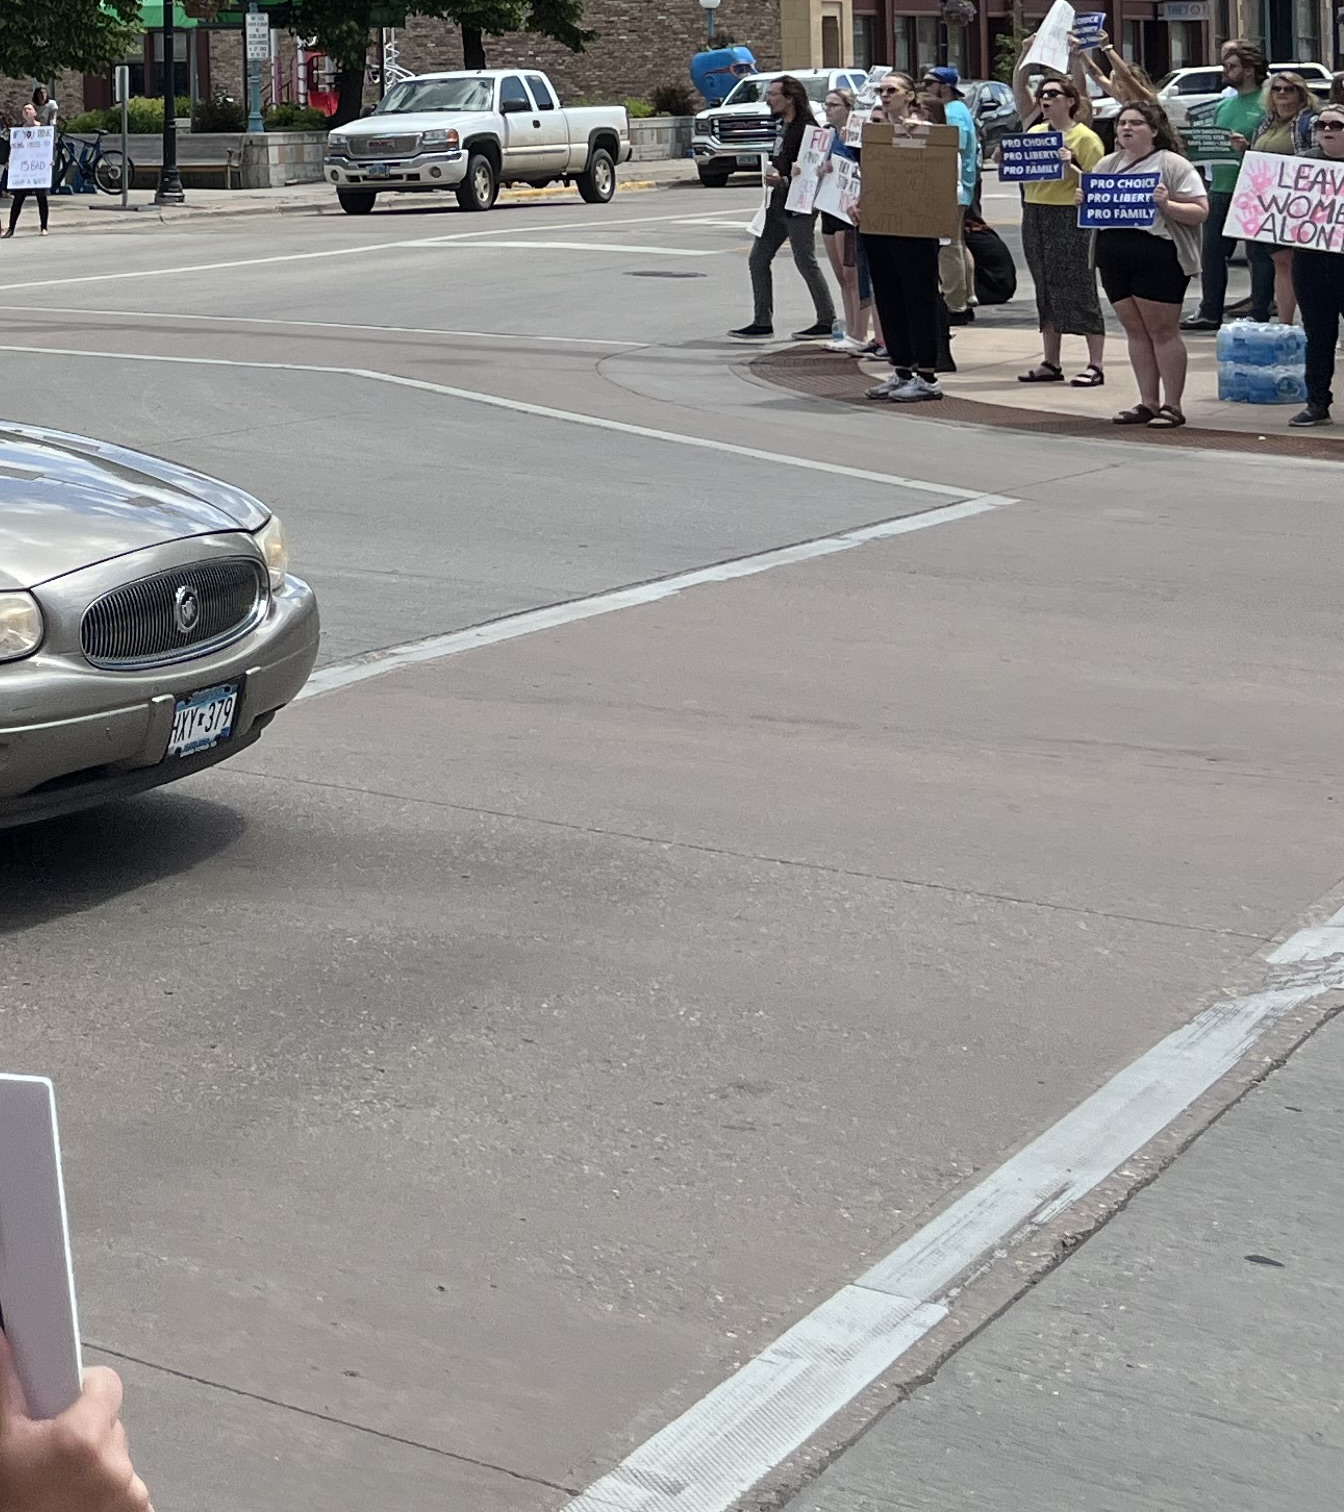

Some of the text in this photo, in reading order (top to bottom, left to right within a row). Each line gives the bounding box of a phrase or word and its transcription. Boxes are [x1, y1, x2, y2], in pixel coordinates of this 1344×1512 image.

[1002, 136, 1058, 148] PRO CHOICE
[1003, 151, 1022, 161] PRO
[1003, 163, 1059, 175] PRO FAMILY
[1090, 177, 1156, 189] PRO CHOICE
[1087, 192, 1153, 204] PRO LIBERT
[1087, 208, 1156, 220] PRO FAMILY
[1253, 213, 1344, 253] ALON
